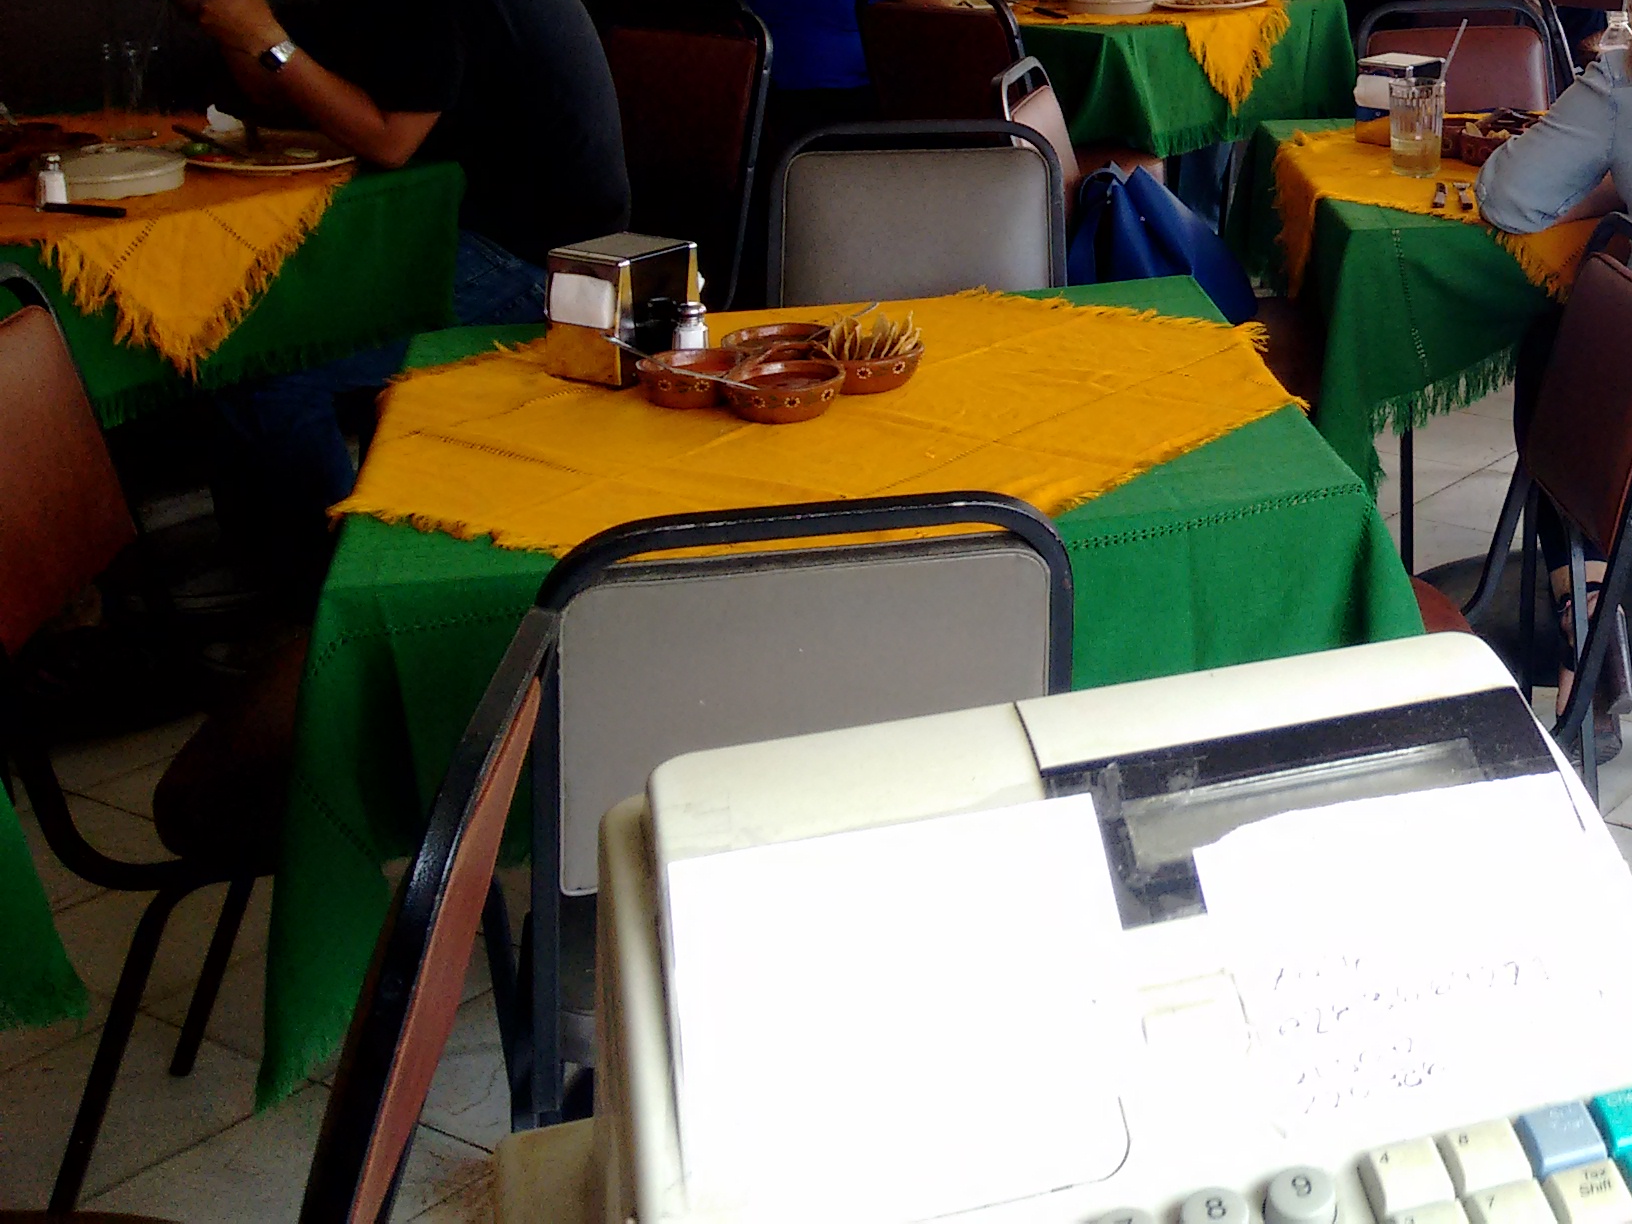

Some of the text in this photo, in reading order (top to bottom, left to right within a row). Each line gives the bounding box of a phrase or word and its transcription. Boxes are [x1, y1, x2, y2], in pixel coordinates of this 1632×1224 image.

[1291, 1174, 1312, 1198] 9
[1579, 1178, 1613, 1197] Shift
[1205, 1197, 1227, 1219] 8
